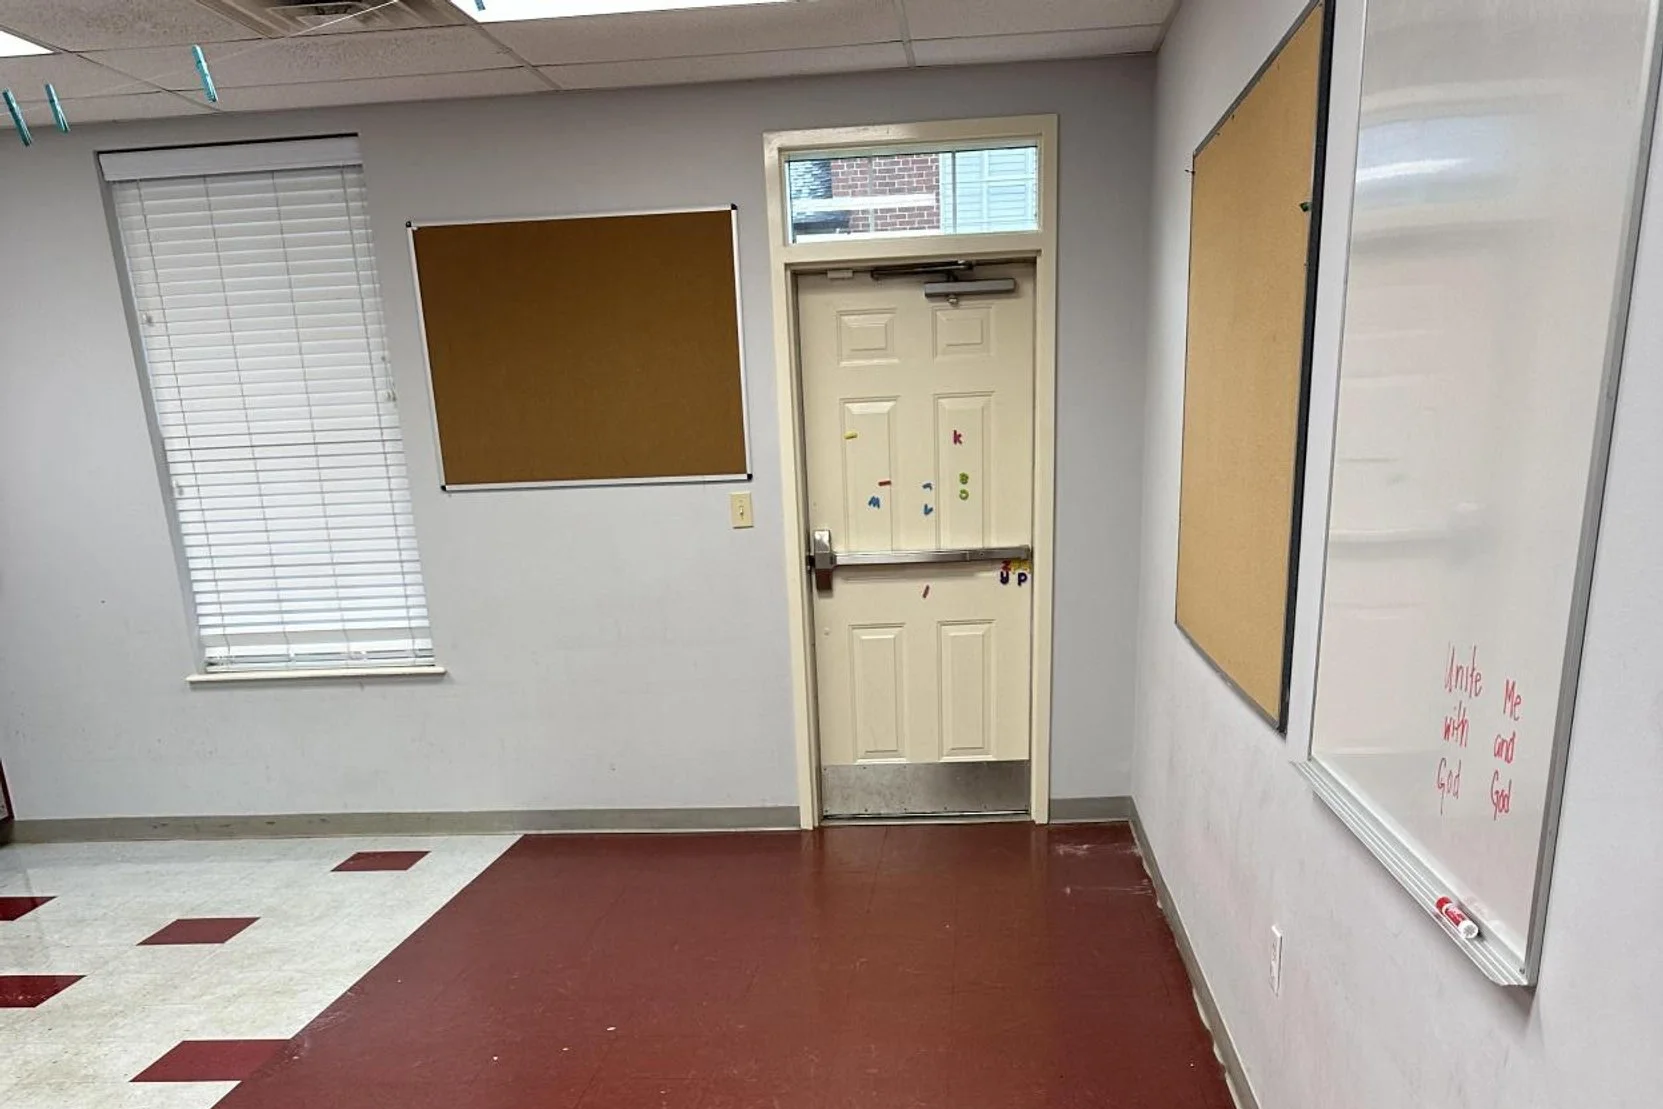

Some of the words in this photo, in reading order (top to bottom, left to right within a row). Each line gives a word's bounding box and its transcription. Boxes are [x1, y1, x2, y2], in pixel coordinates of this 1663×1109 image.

[1443, 700, 1469, 747] with
[1503, 679, 1522, 721] Me
[1494, 731, 1516, 764] and
[1437, 757, 1462, 816] God
[1490, 769, 1513, 821] God
